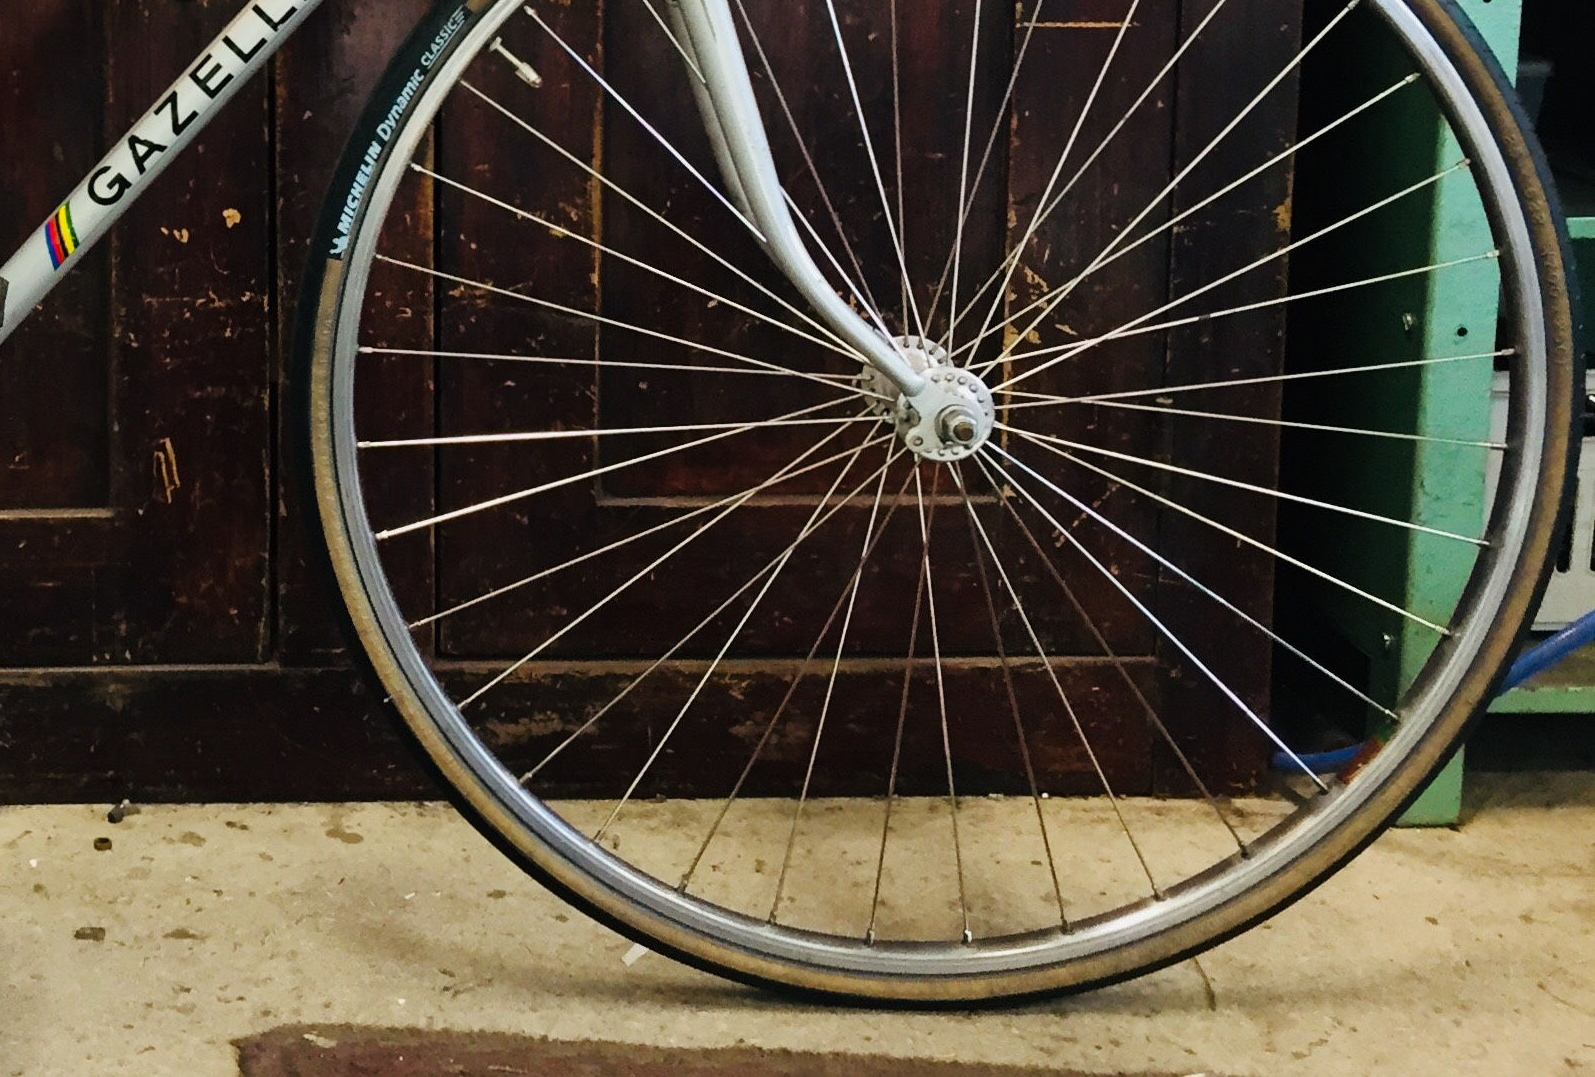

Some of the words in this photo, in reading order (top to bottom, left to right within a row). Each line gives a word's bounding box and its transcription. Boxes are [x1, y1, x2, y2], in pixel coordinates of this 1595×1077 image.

[337, 140, 383, 235] MICHELIN
[376, 68, 426, 142] Dynamic
[420, 8, 464, 68] CLASSIC
